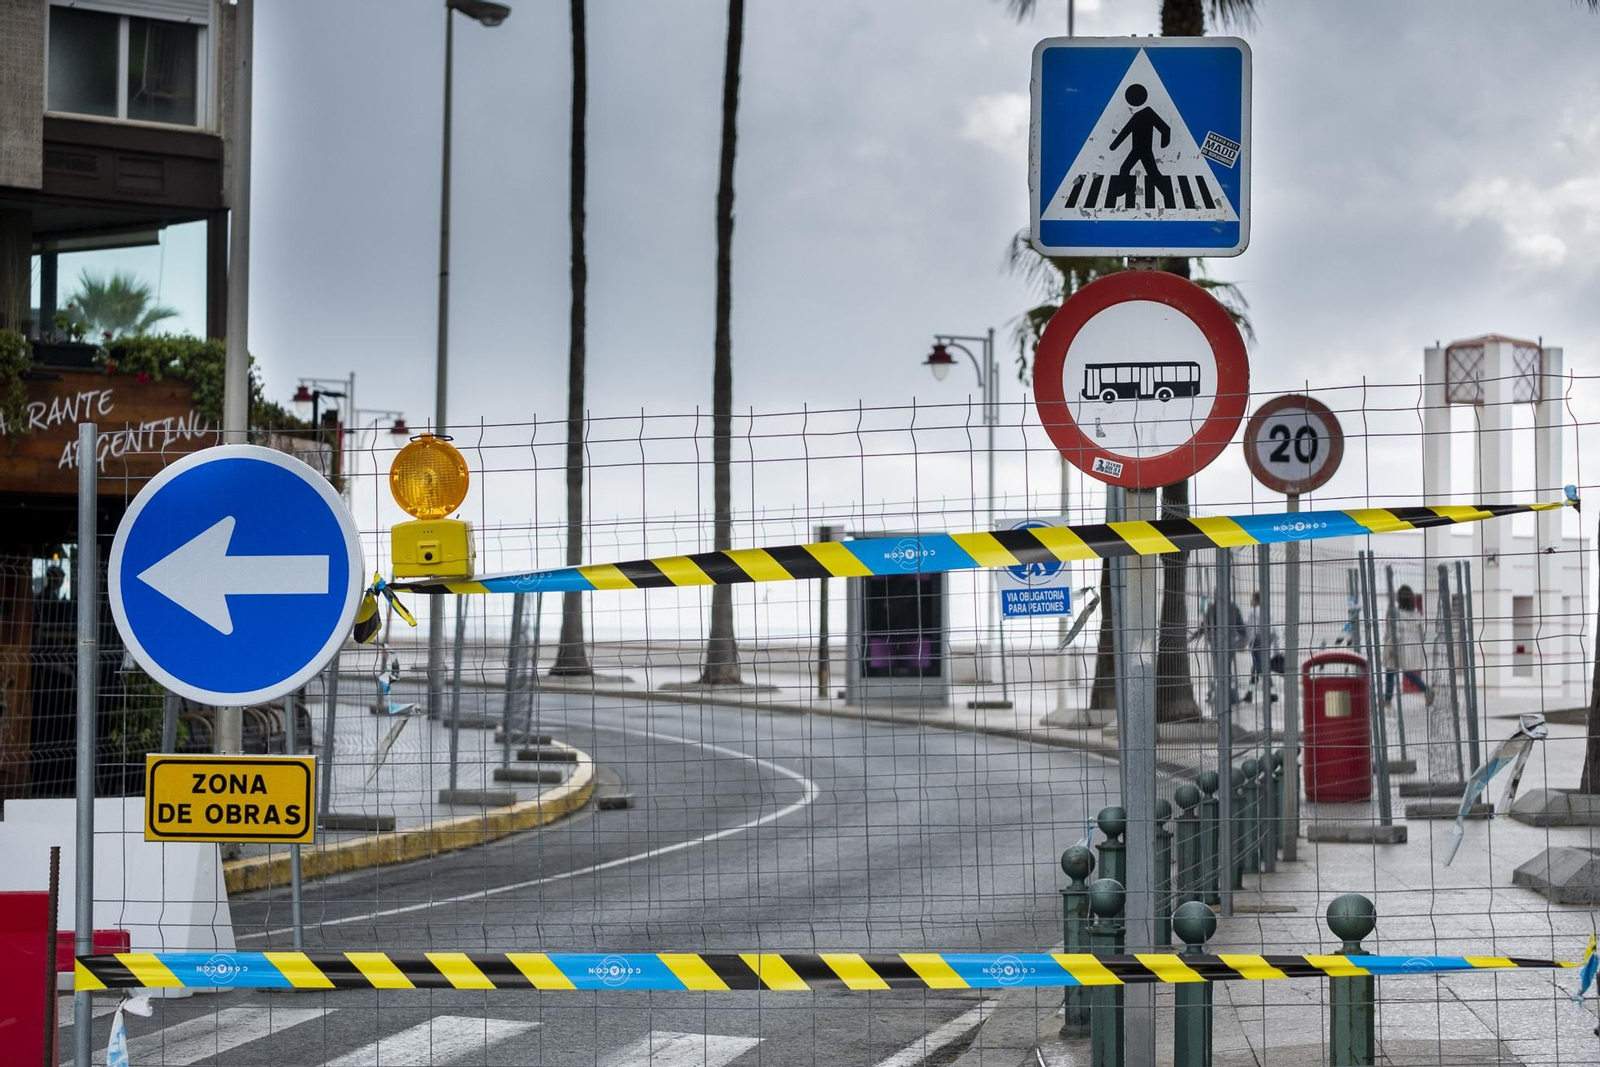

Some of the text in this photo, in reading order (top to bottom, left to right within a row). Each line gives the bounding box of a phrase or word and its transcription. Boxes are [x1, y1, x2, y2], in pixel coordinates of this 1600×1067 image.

[1269, 424, 1319, 464] 20
[1272, 523, 1328, 532] CONACON
[884, 549, 936, 560] CONACON
[1007, 590, 1064, 602] VIA OBLIGATORIA
[1008, 601, 1064, 613] PARA PEATONES
[191, 773, 268, 794] ZONA
[158, 803, 301, 825] DE OBRAS
[196, 965, 248, 974] CONACON
[588, 966, 642, 976] CONACON
[982, 965, 1036, 975] CONACON
